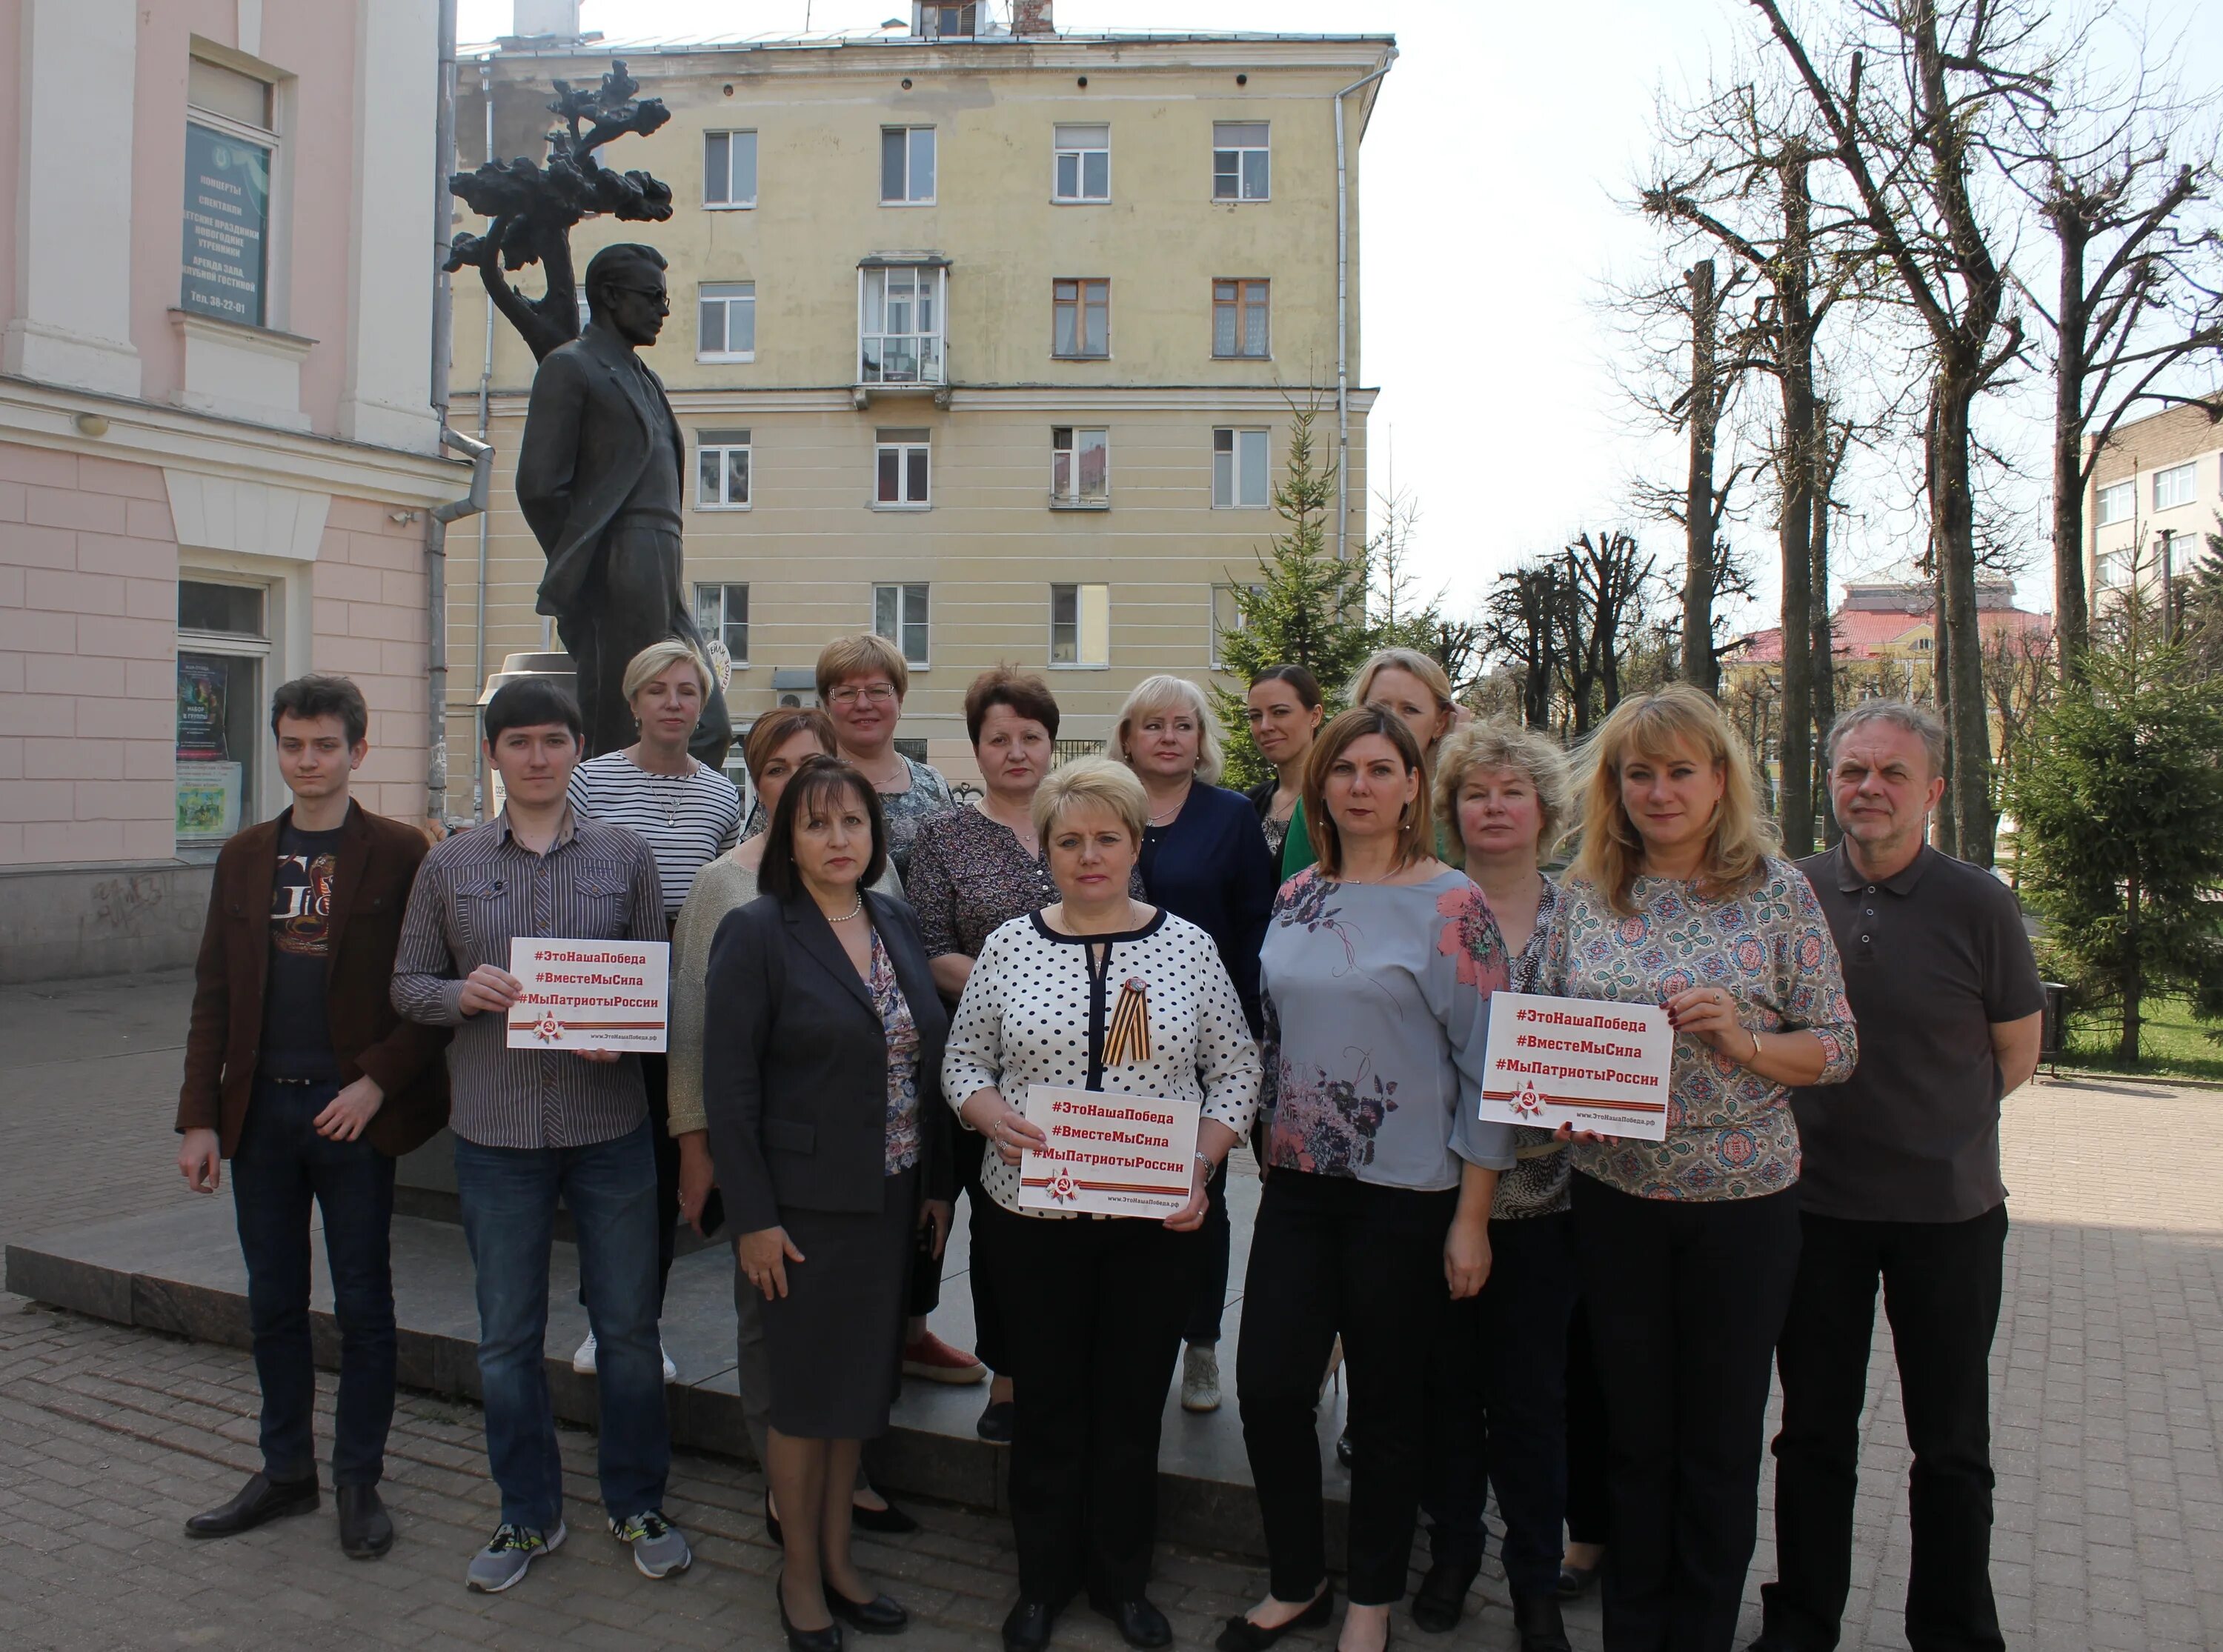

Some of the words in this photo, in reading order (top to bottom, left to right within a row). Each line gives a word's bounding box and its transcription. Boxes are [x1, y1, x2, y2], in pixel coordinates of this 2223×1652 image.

[200, 175, 242, 196] КОНЦЕРТЫ
[199, 195, 242, 216] СПЕКТАКЛИ
[195, 225, 244, 247] НОВОГОДНИЕ
[214, 219, 259, 241] ПРАЗДНИКИ
[198, 238, 241, 258] УТРЕННИКИ
[193, 256, 223, 272] АРЕНДА
[218, 274, 256, 293] ГОСТИНОЙ
[190, 290, 208, 304] Тел.
[534, 950, 646, 965] #ЭтоНашаПобеда
[535, 973, 643, 986] #ВместеМыСила
[519, 993, 659, 1008] #МыПатриотыРоссии
[1516, 1009, 1647, 1033] #ЭтоНашаПобеда
[591, 1033, 657, 1042] www.ЭтоНашаПобеда.рф
[1516, 1035, 1642, 1059] #ВместеМыСила
[1495, 1059, 1659, 1087] #МыПатриотыРоссии
[1051, 1101, 1174, 1125] #ЭтоНашаПобеда
[1576, 1111, 1655, 1126] www.ЭтоНашаПобеда.рф
[1051, 1125, 1169, 1148] #ВместеМыСила
[1032, 1148, 1184, 1173] #МыПатриотыРоссии
[1107, 1196, 1180, 1208] www.ЭтоНашаПобеда.рф
